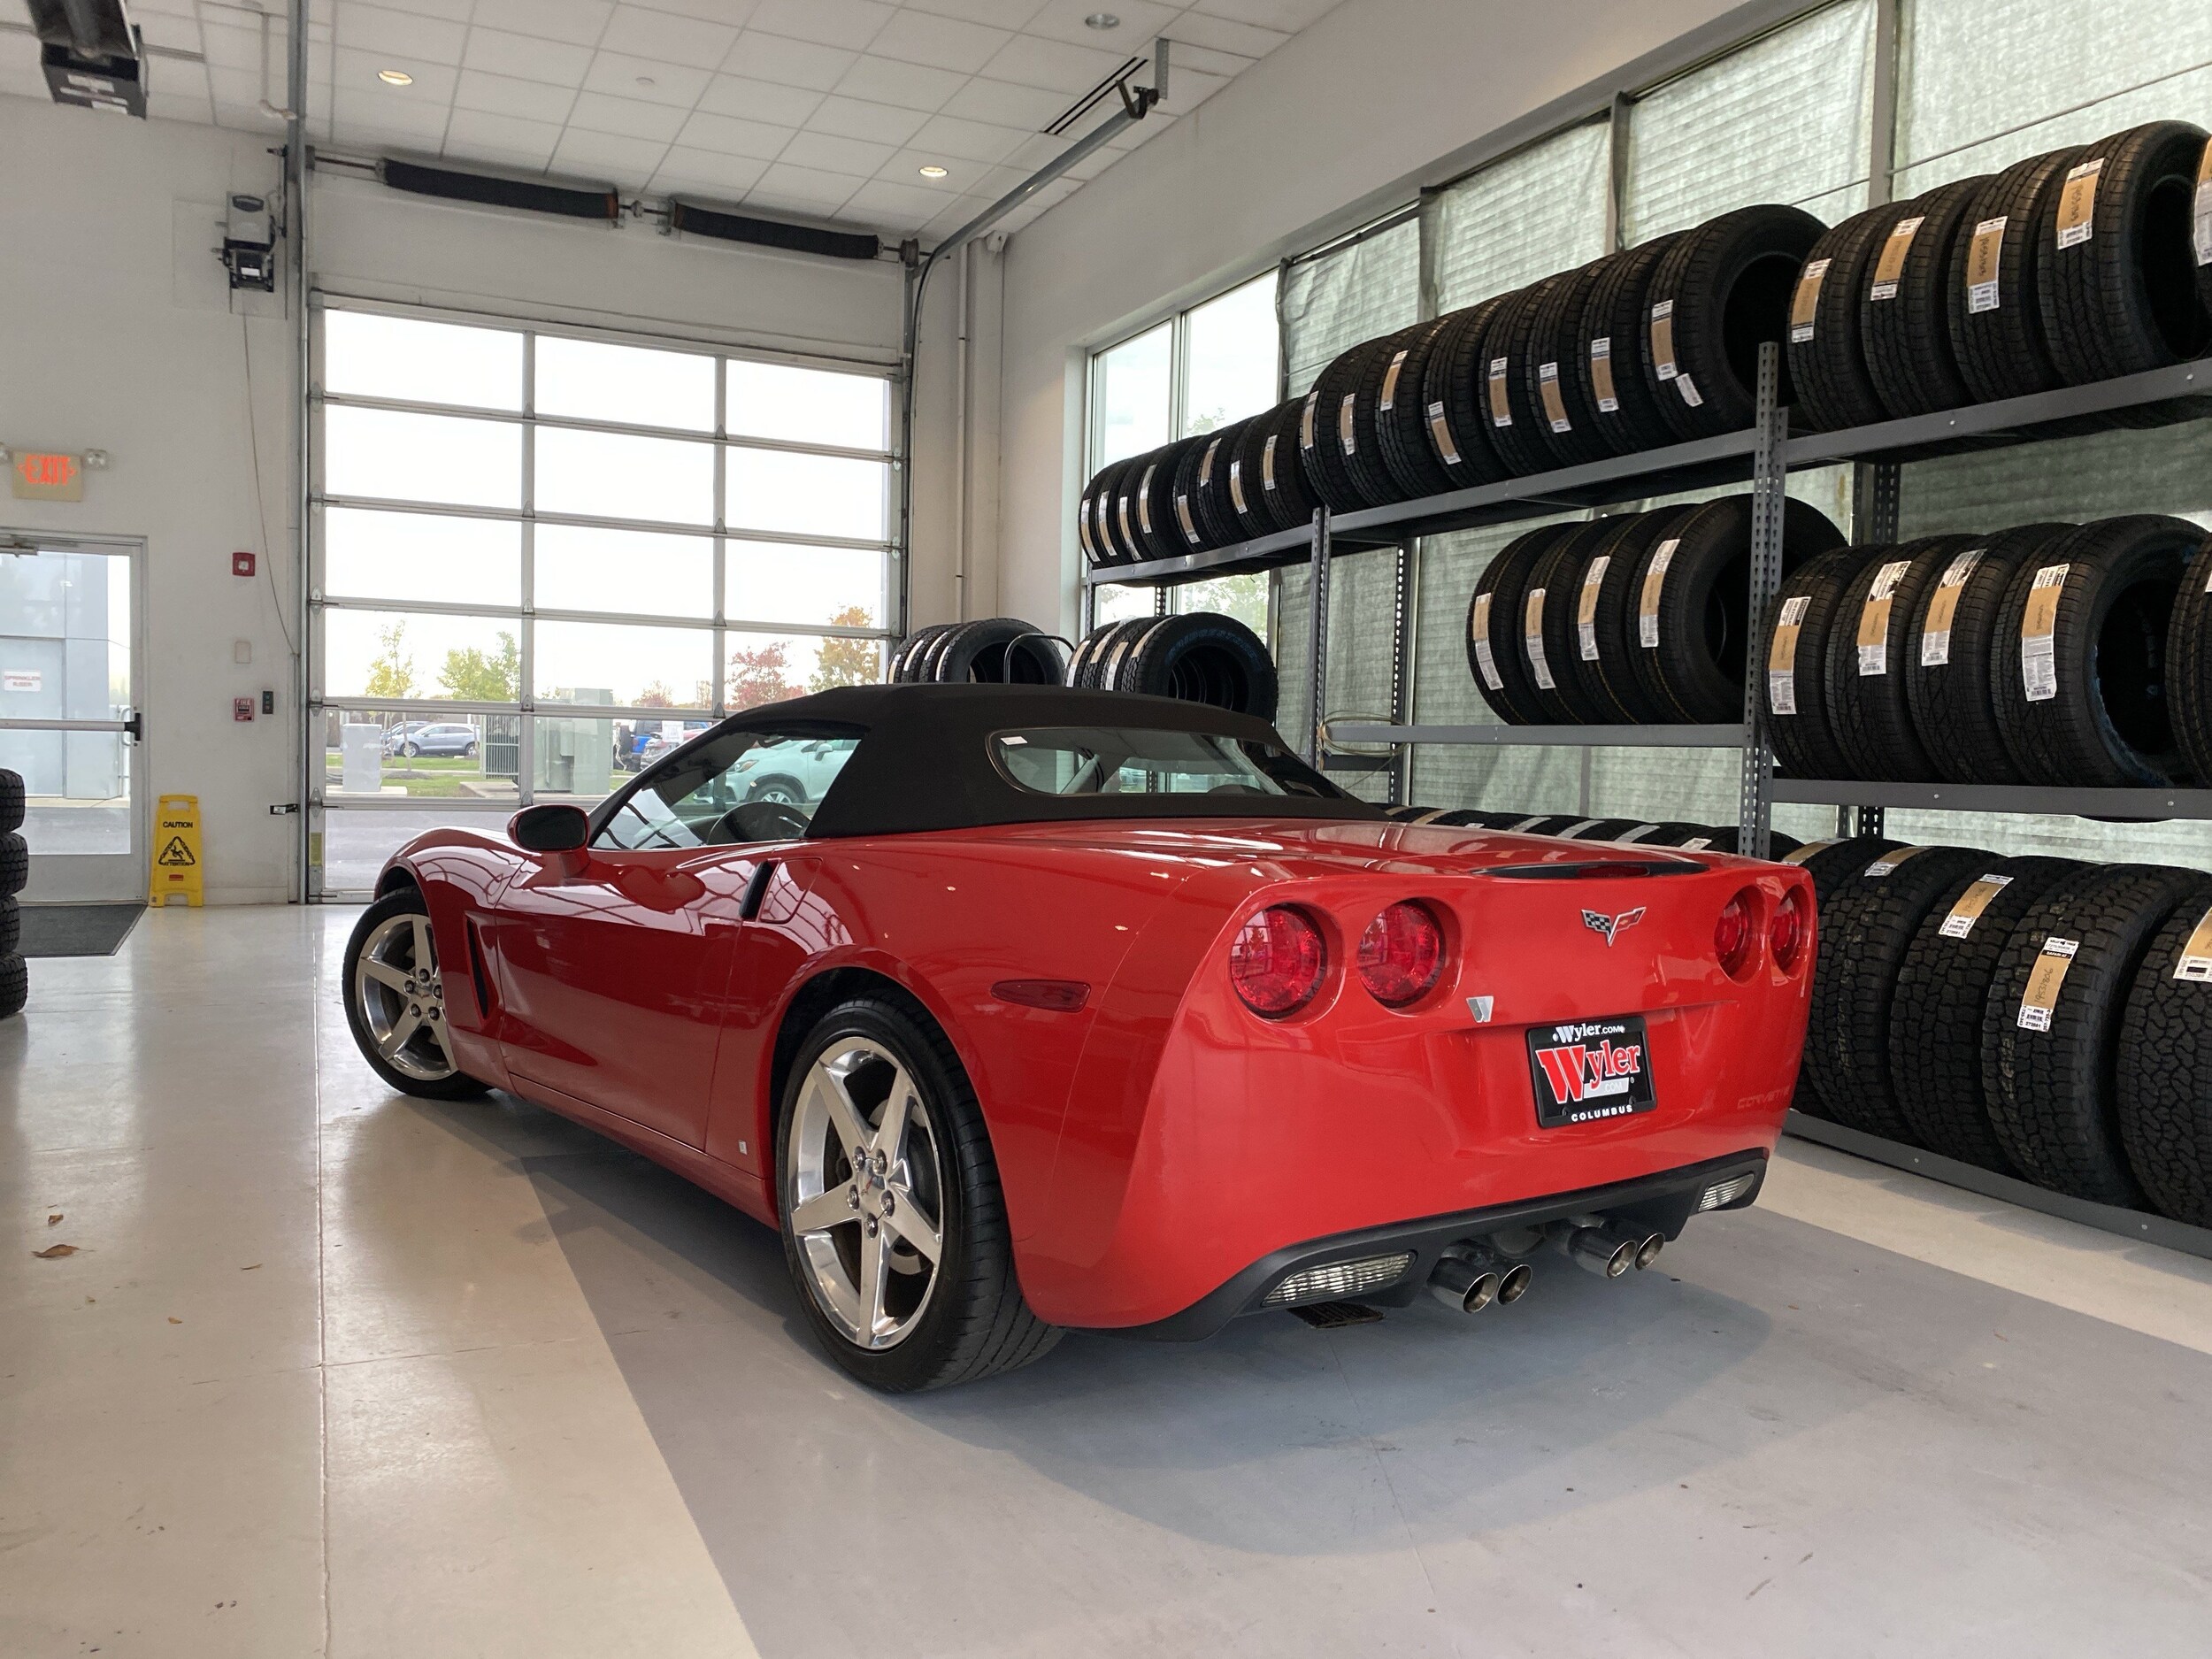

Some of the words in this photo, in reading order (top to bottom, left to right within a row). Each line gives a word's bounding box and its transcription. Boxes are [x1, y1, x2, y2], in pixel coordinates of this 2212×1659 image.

[26, 454, 71, 486] EXIT
[1535, 1039, 1641, 1104] Wyler
[1571, 1104, 1633, 1122] COLUMBUS
